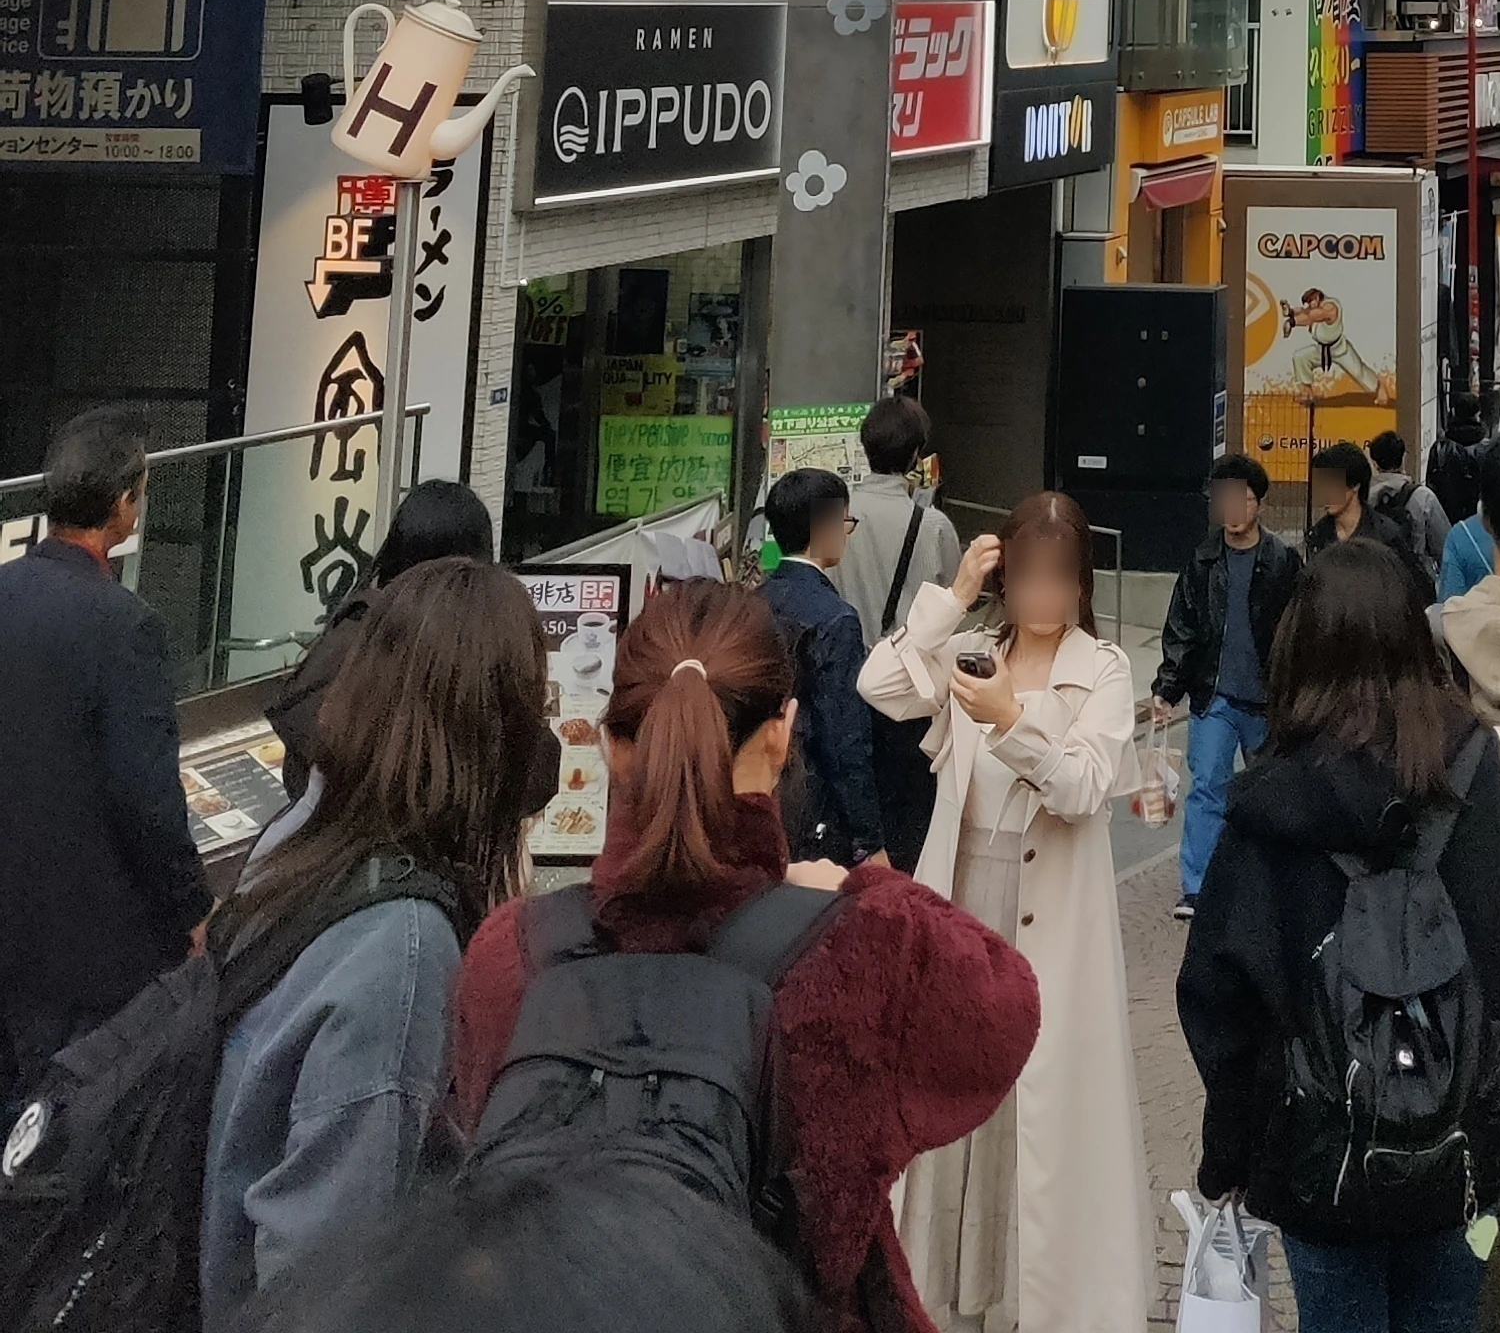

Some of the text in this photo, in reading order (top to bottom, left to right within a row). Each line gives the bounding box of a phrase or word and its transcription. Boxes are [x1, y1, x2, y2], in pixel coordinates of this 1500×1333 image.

[636, 28, 713, 51] RAMEN
[346, 62, 438, 159] H
[595, 79, 772, 155] IPPUDO
[1024, 93, 1092, 163] DOUTOR
[158, 144, 194, 159] 18:00
[325, 218, 373, 260] BF
[1257, 232, 1386, 260] CAPCOM
